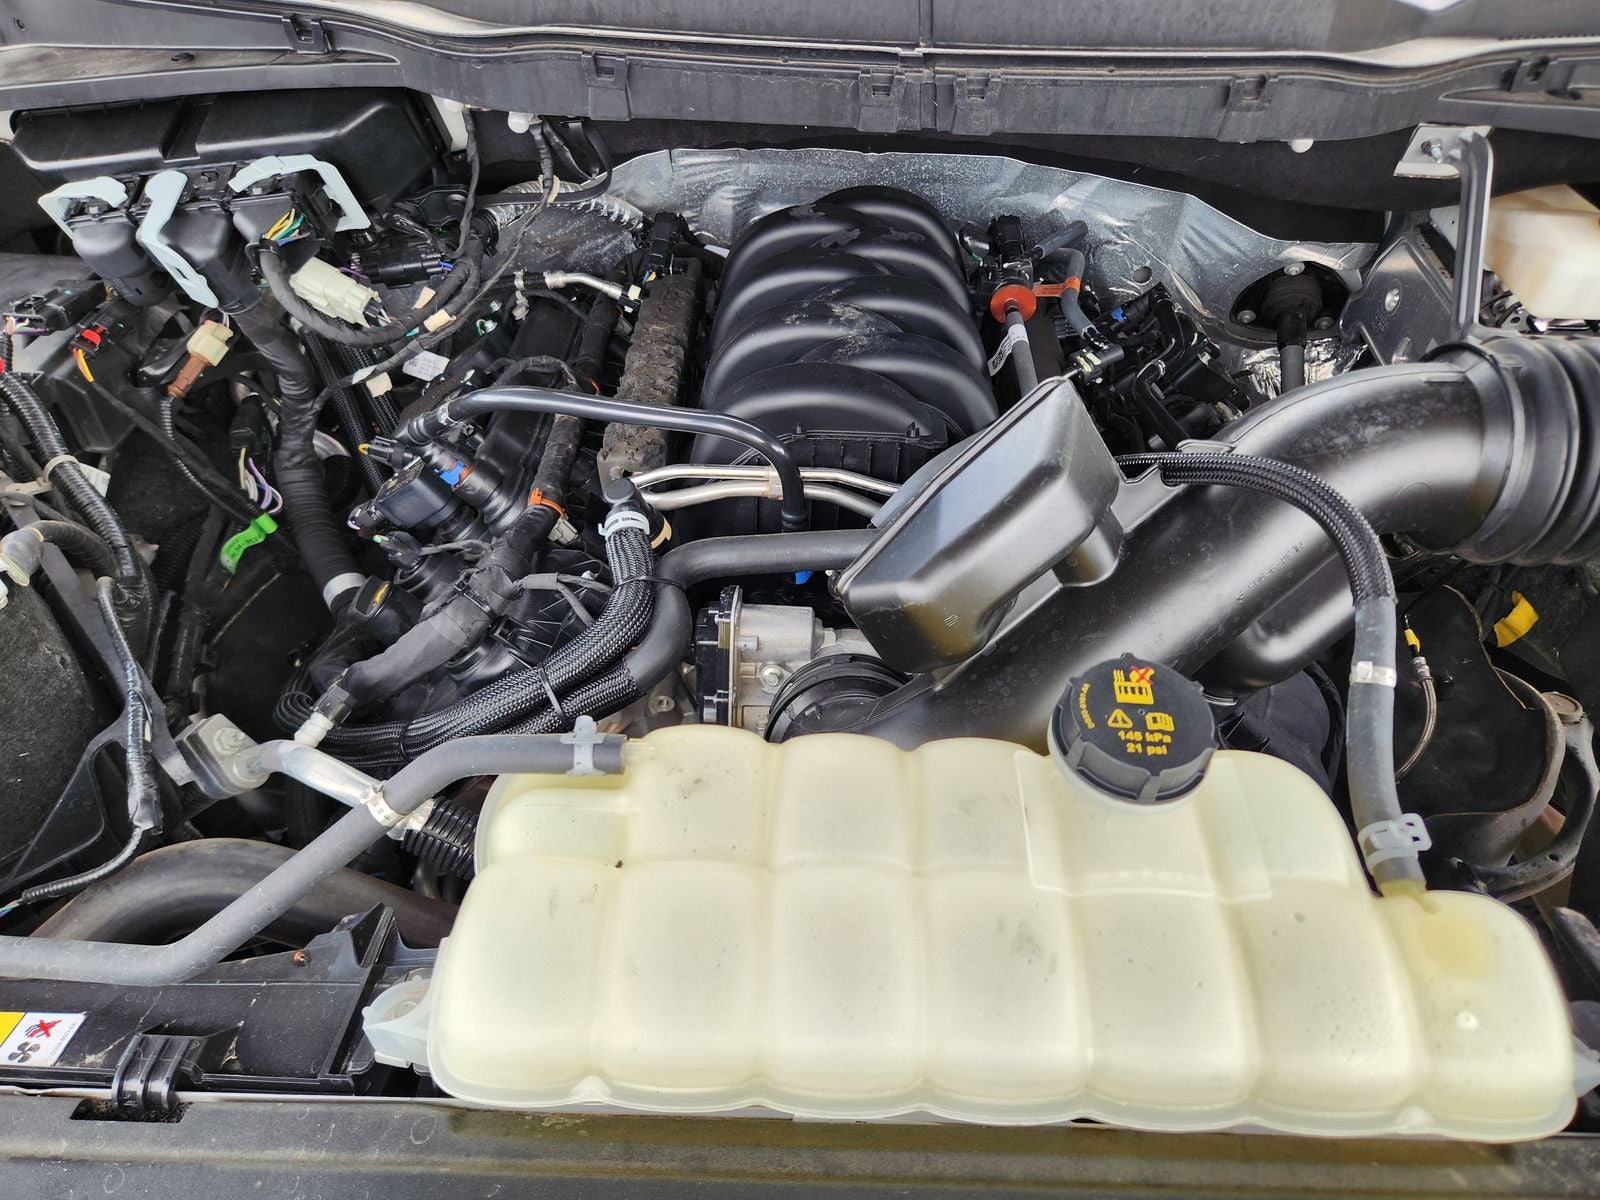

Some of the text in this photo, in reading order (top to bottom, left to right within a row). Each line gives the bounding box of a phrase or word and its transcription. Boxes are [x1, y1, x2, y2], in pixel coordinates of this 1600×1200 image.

[1118, 731, 1172, 743] 145 kPa
[1127, 744, 1167, 756] 21 psi
